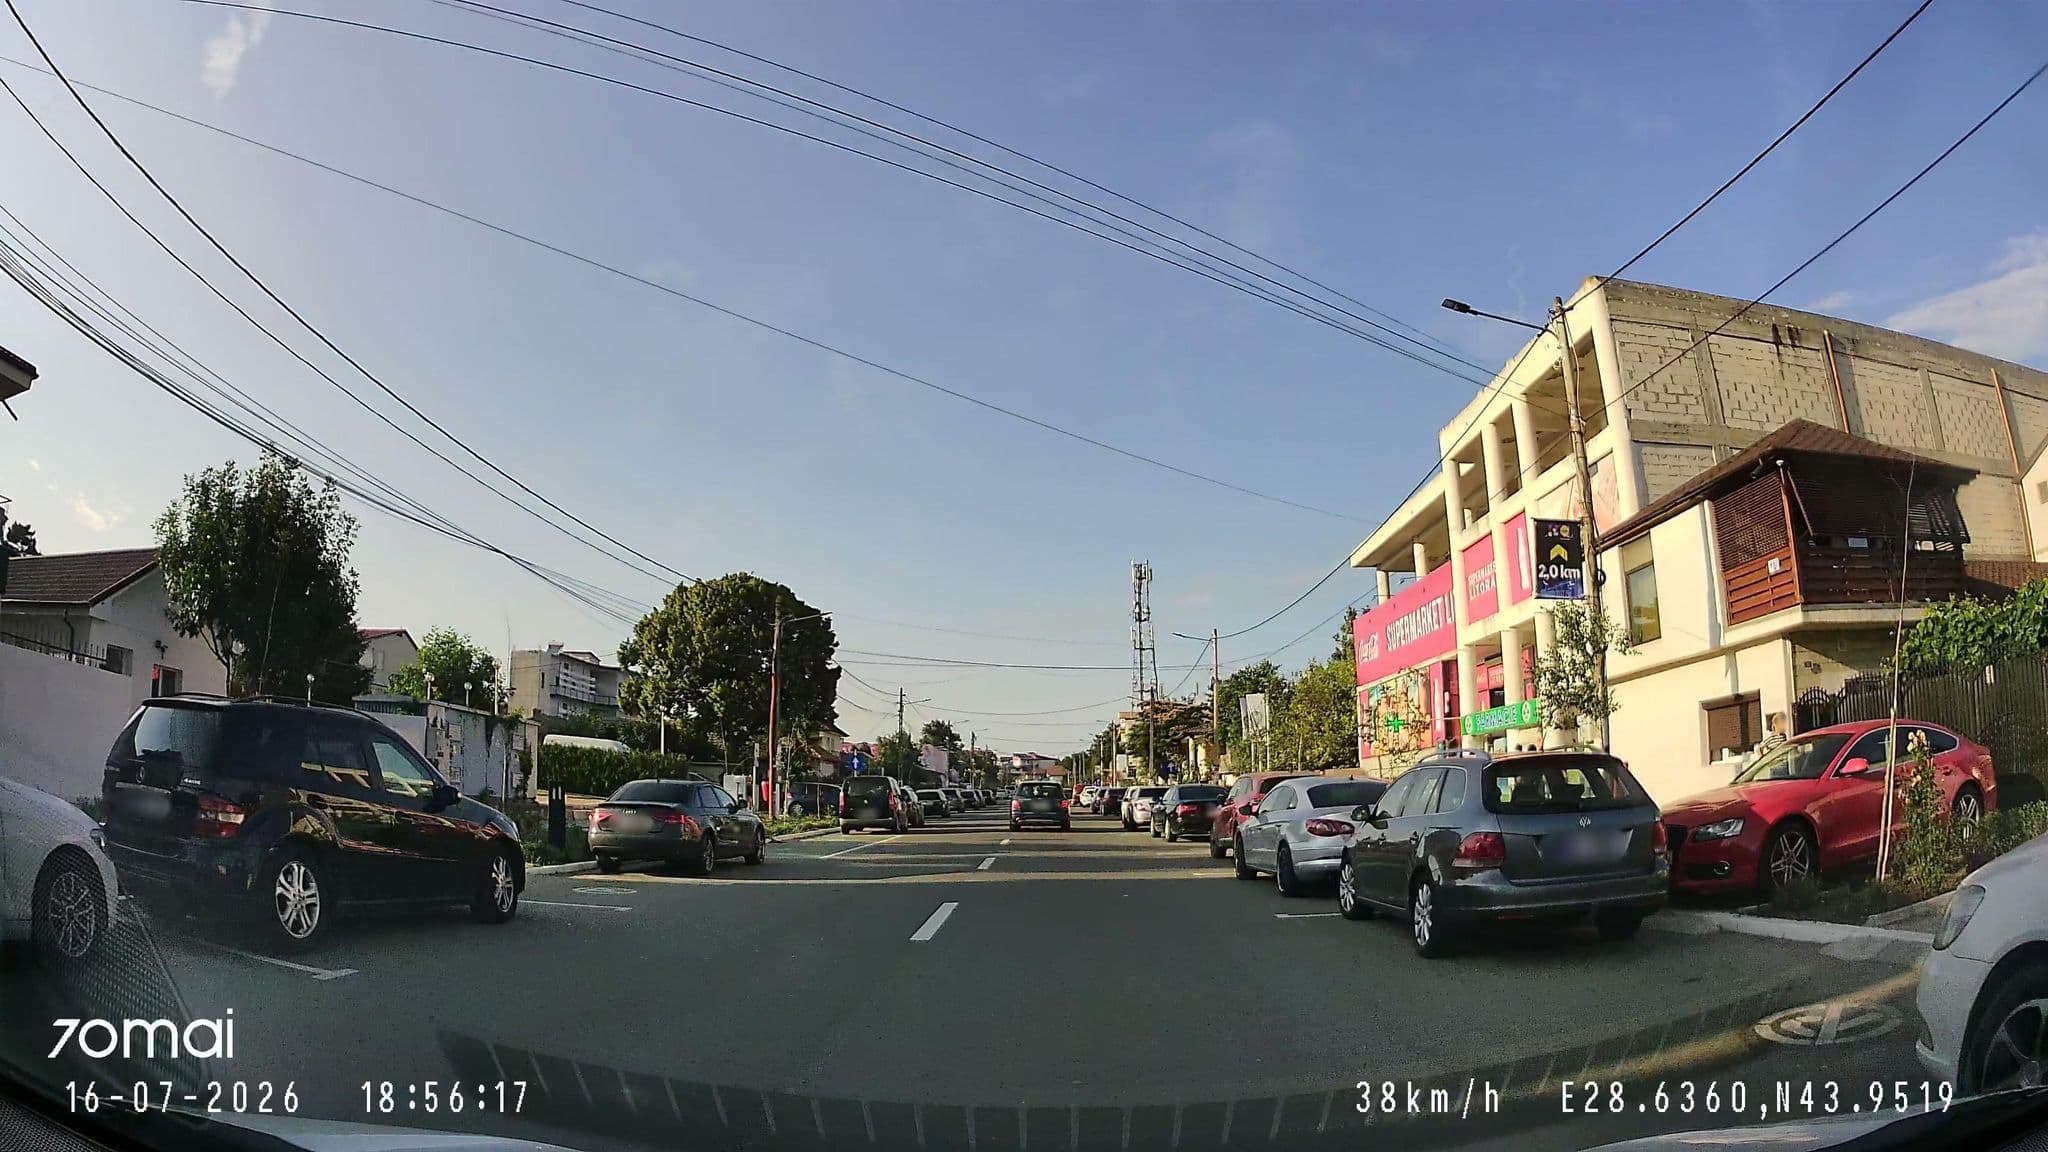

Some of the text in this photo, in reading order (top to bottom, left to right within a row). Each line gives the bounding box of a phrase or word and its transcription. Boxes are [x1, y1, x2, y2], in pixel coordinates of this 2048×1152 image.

[1538, 564, 1581, 580] 2,0 km
[1386, 596, 1443, 652] SUPERMARKET
[1476, 705, 1517, 731] FARMACIE
